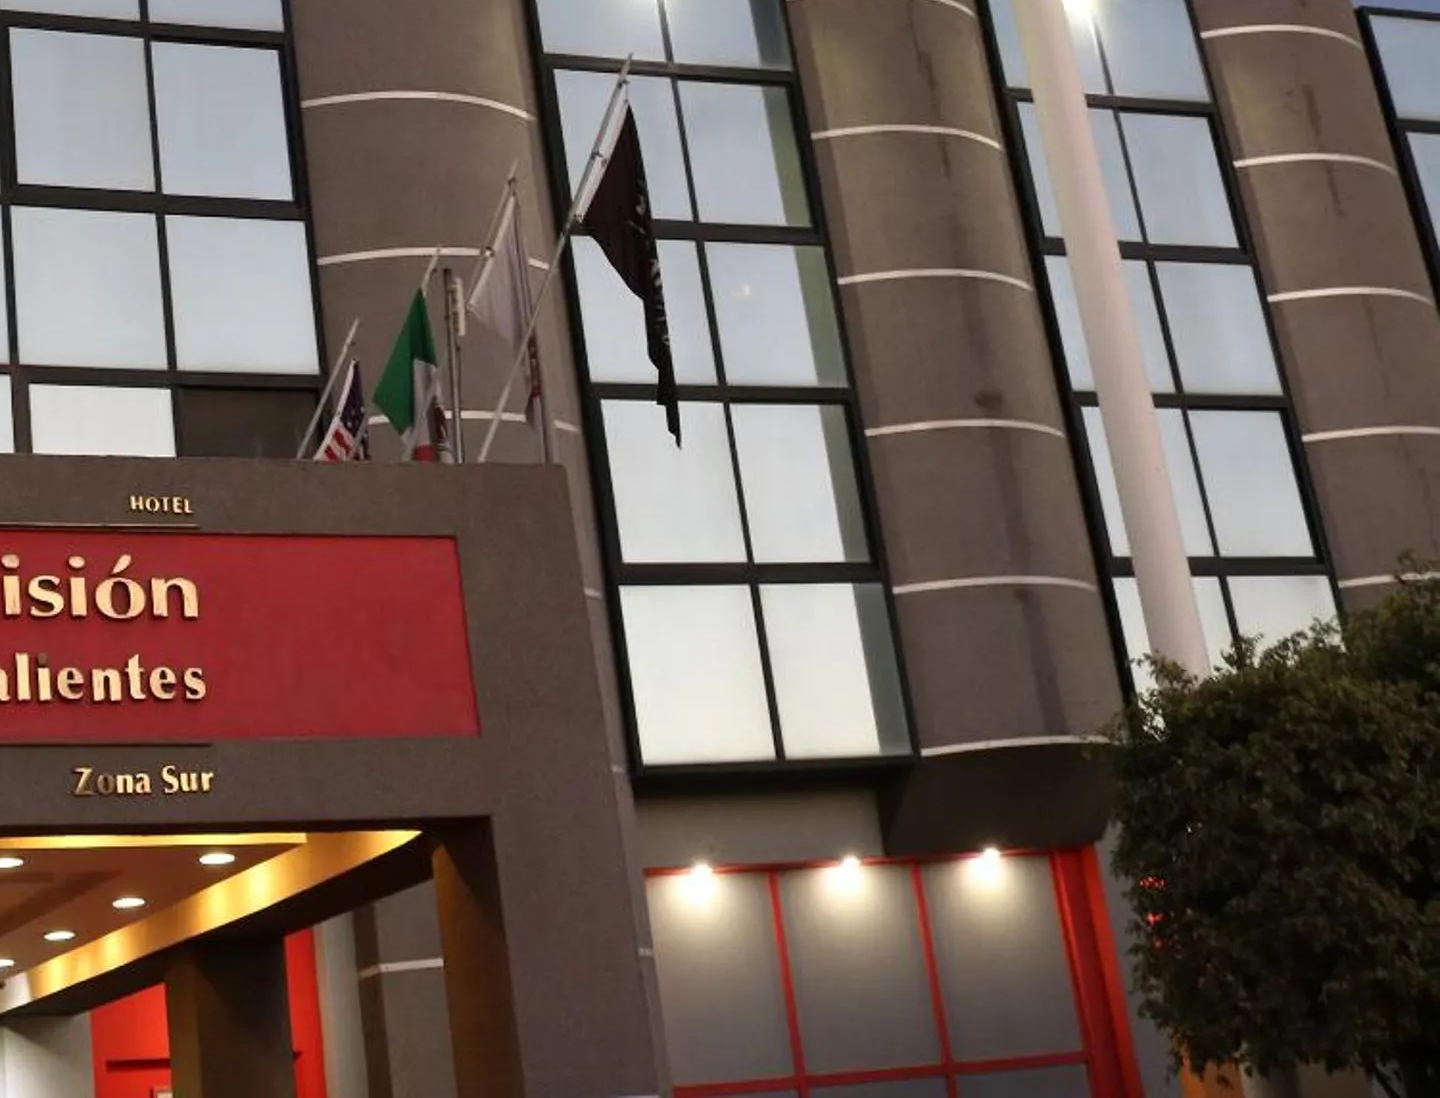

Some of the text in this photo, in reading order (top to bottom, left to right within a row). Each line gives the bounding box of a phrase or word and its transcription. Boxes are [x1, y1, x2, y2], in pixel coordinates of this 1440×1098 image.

[129, 494, 194, 514] HOTEL
[72, 765, 215, 796] Zona Sur
